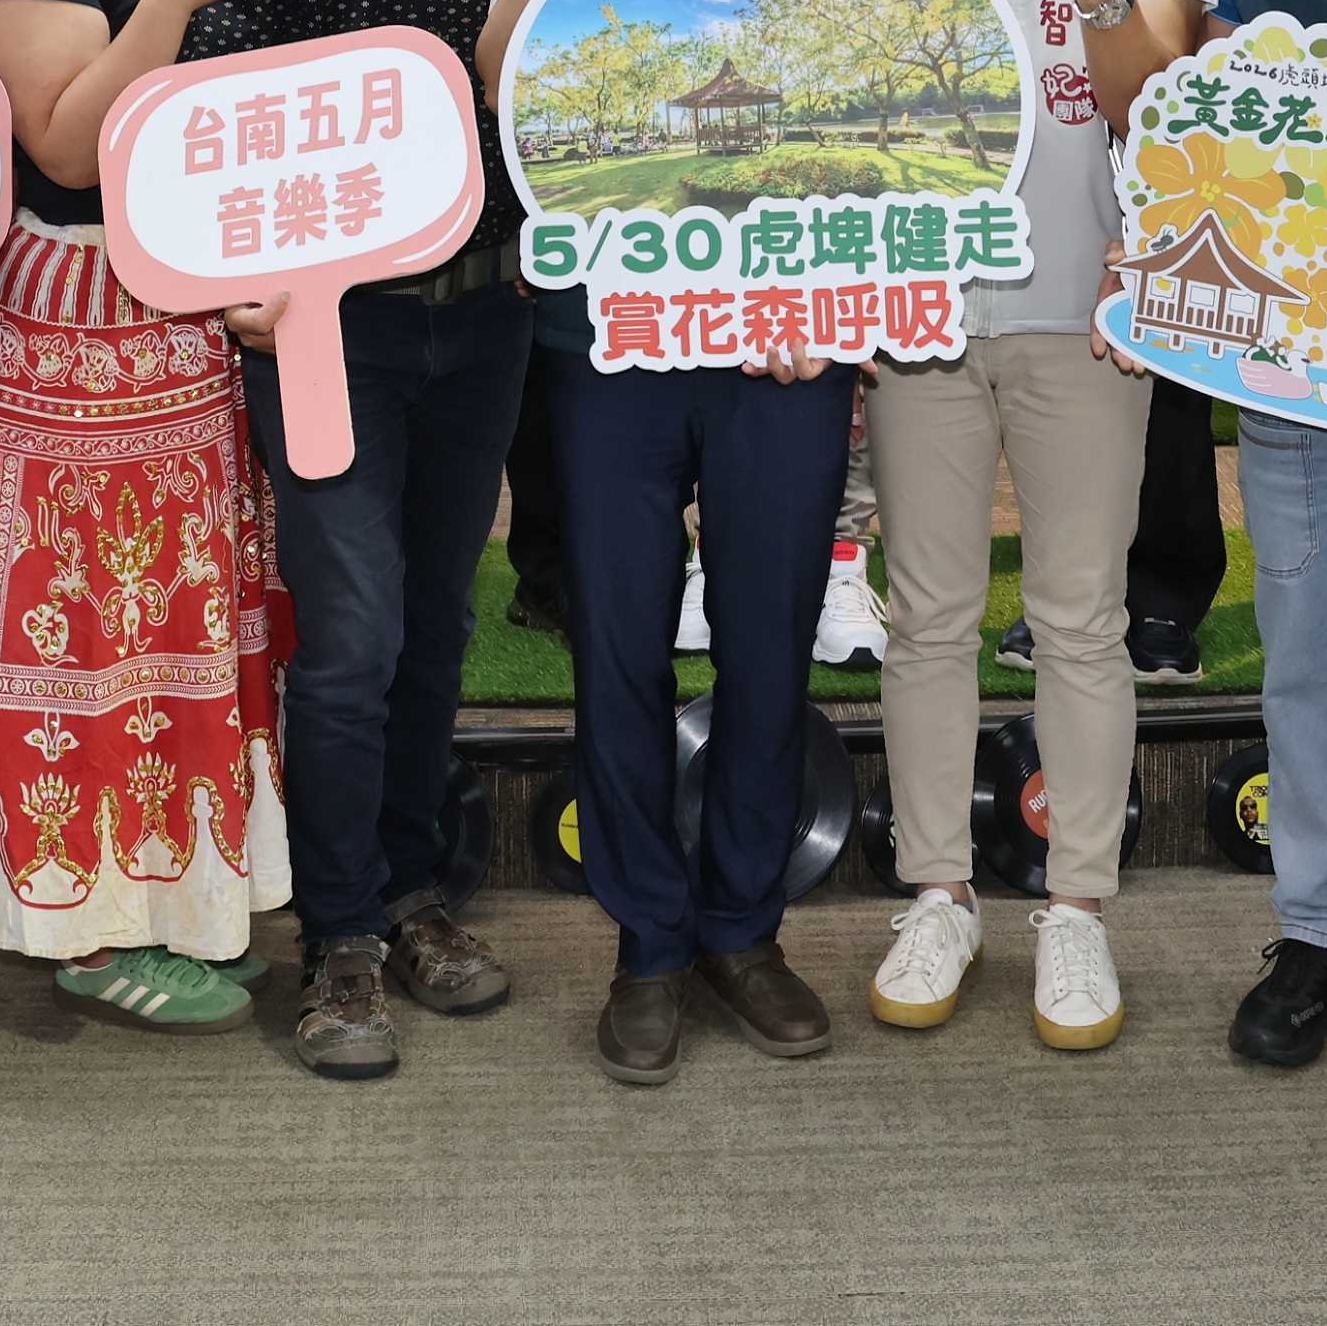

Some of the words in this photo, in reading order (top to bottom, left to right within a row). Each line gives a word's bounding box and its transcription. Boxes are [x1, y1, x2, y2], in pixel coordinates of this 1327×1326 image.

[182, 66, 404, 176] 台南五月
[1053, 96, 1097, 122] 團隊
[215, 162, 386, 260] 音樂季
[531, 217, 723, 276] 5/30
[738, 200, 1022, 280] 虎埤健走
[600, 280, 954, 361] 賞花森呼吸
